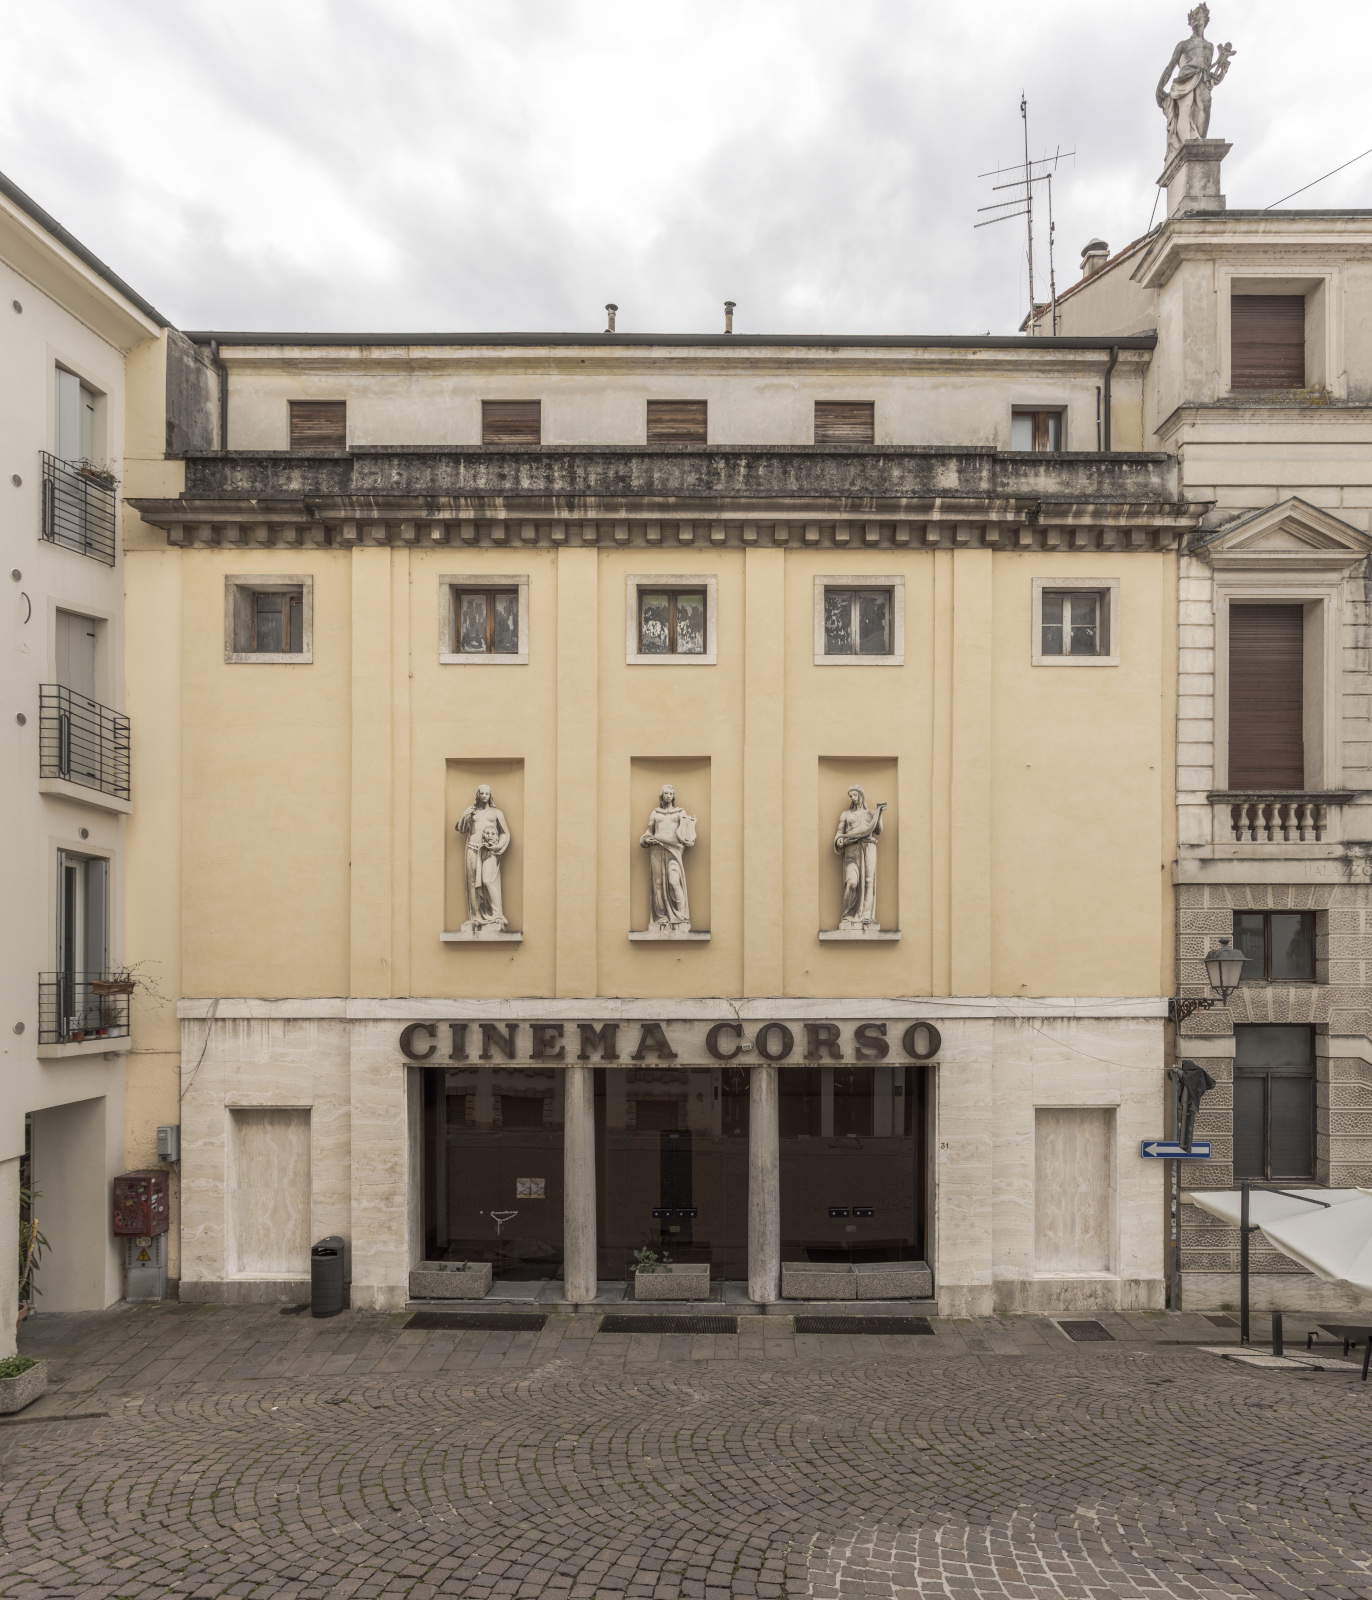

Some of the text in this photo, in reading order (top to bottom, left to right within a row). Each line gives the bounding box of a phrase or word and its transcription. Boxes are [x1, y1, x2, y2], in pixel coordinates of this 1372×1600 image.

[399, 1021, 942, 1061] CINEMA CORSO
[940, 1142, 949, 1150] 31
